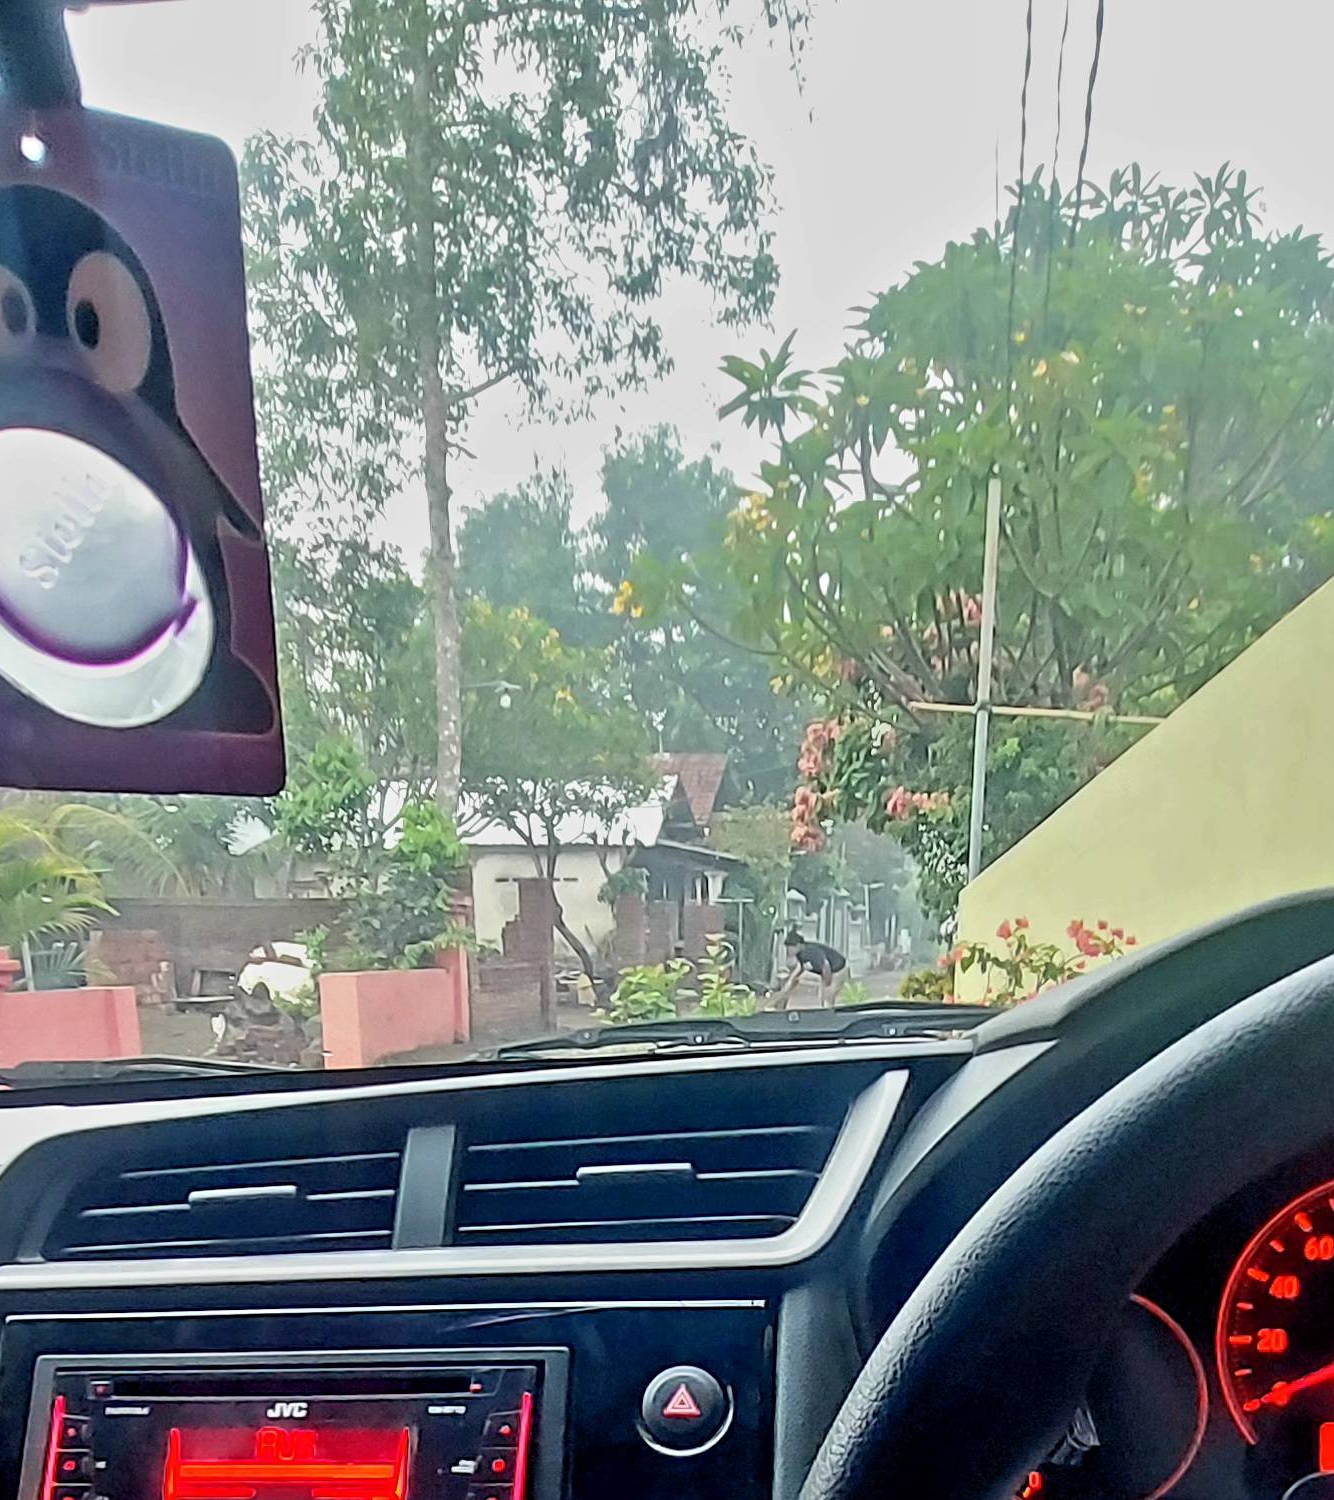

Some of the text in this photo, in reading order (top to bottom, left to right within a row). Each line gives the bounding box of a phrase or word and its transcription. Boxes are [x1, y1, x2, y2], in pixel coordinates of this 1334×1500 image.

[1269, 1275, 1300, 1299] 40
[1257, 1328, 1287, 1352] 20
[267, 1402, 308, 1418] JVC
